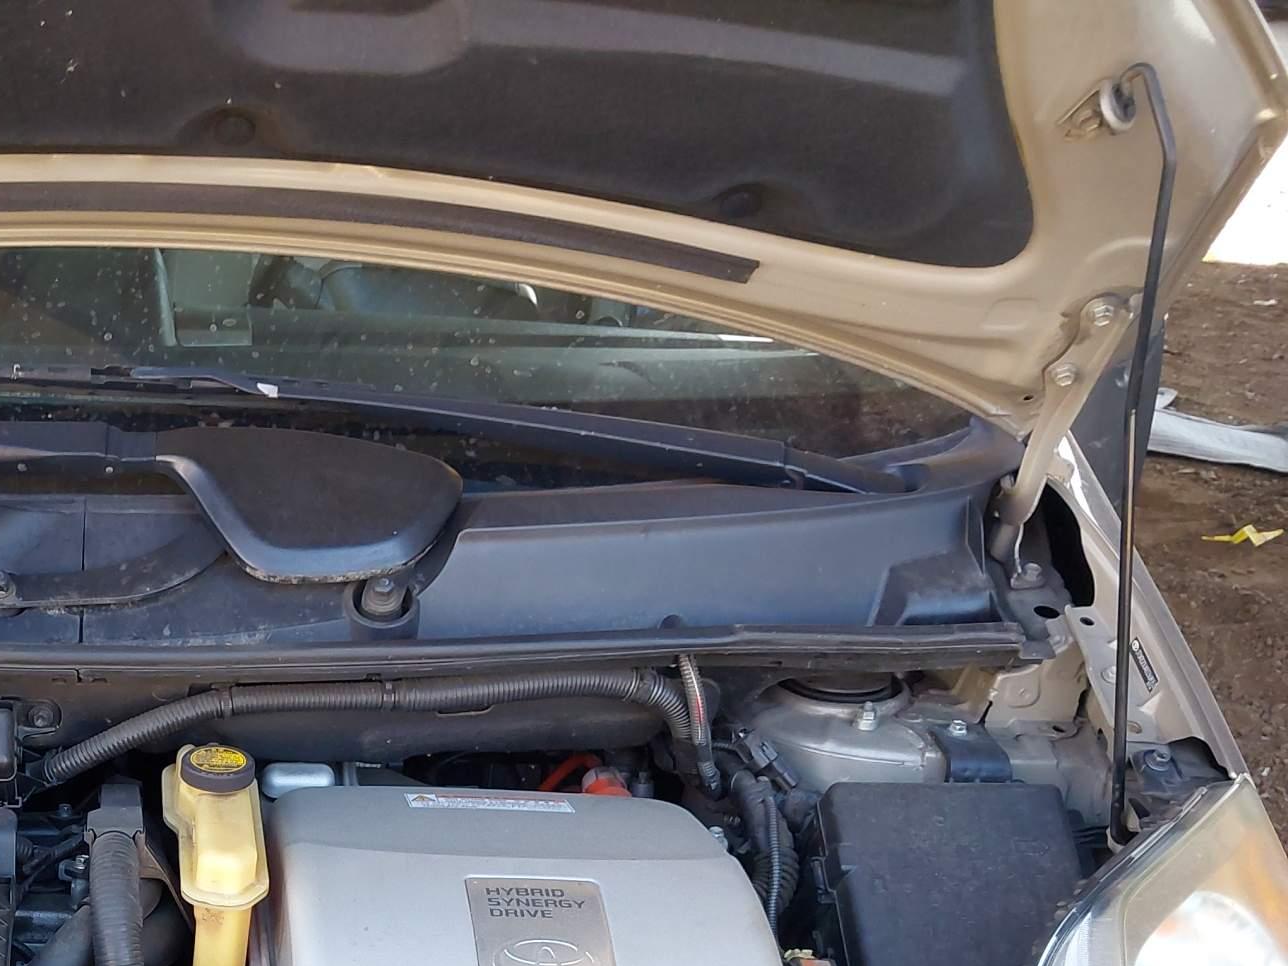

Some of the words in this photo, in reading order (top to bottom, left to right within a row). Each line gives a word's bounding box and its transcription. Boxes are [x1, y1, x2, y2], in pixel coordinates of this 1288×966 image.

[485, 887, 565, 898] HYBRID
[487, 897, 585, 909] SYNERGY
[489, 908, 553, 919] DRIVE
